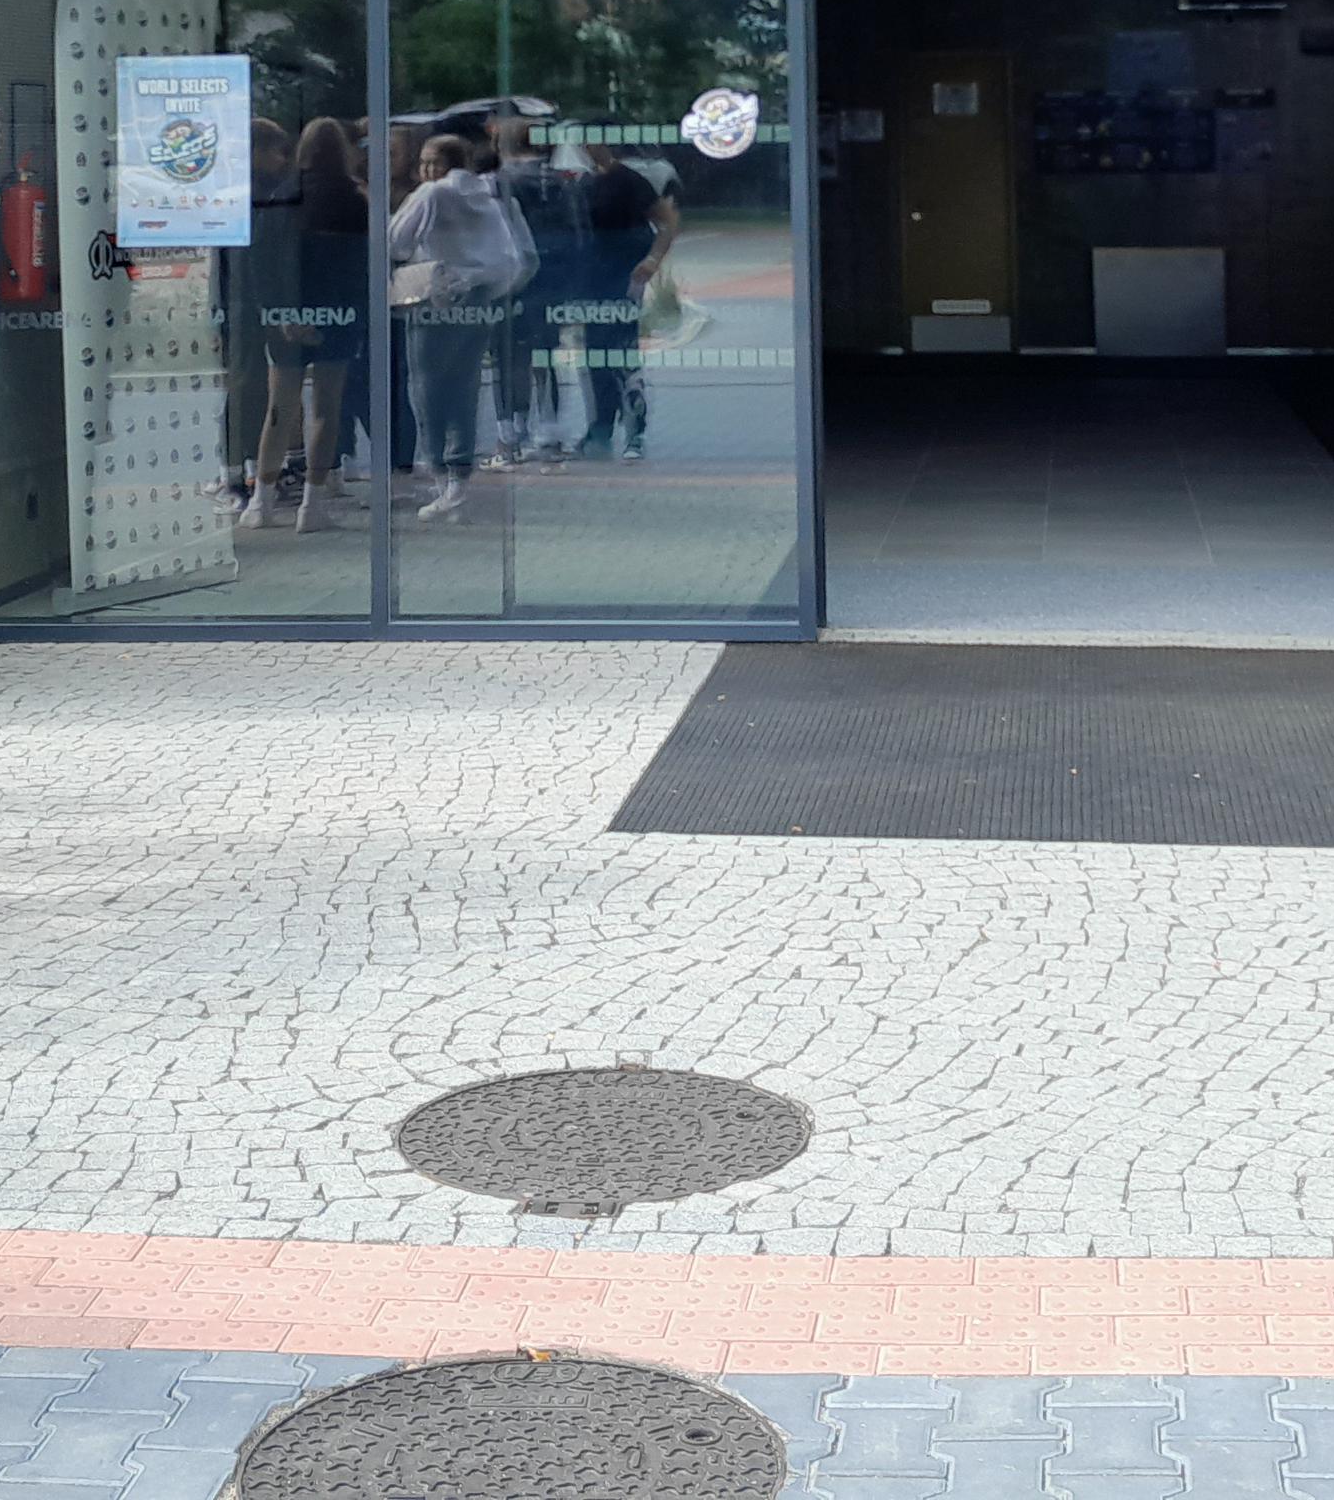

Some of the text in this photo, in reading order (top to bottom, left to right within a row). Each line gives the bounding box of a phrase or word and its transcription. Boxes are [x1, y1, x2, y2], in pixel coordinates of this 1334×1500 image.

[138, 78, 229, 95] WORLD SELECTS
[165, 97, 202, 113] INVITE
[260, 306, 357, 327] ICEARENA
[409, 305, 505, 326] ICEARENA
[545, 304, 640, 325] ICEARENA
